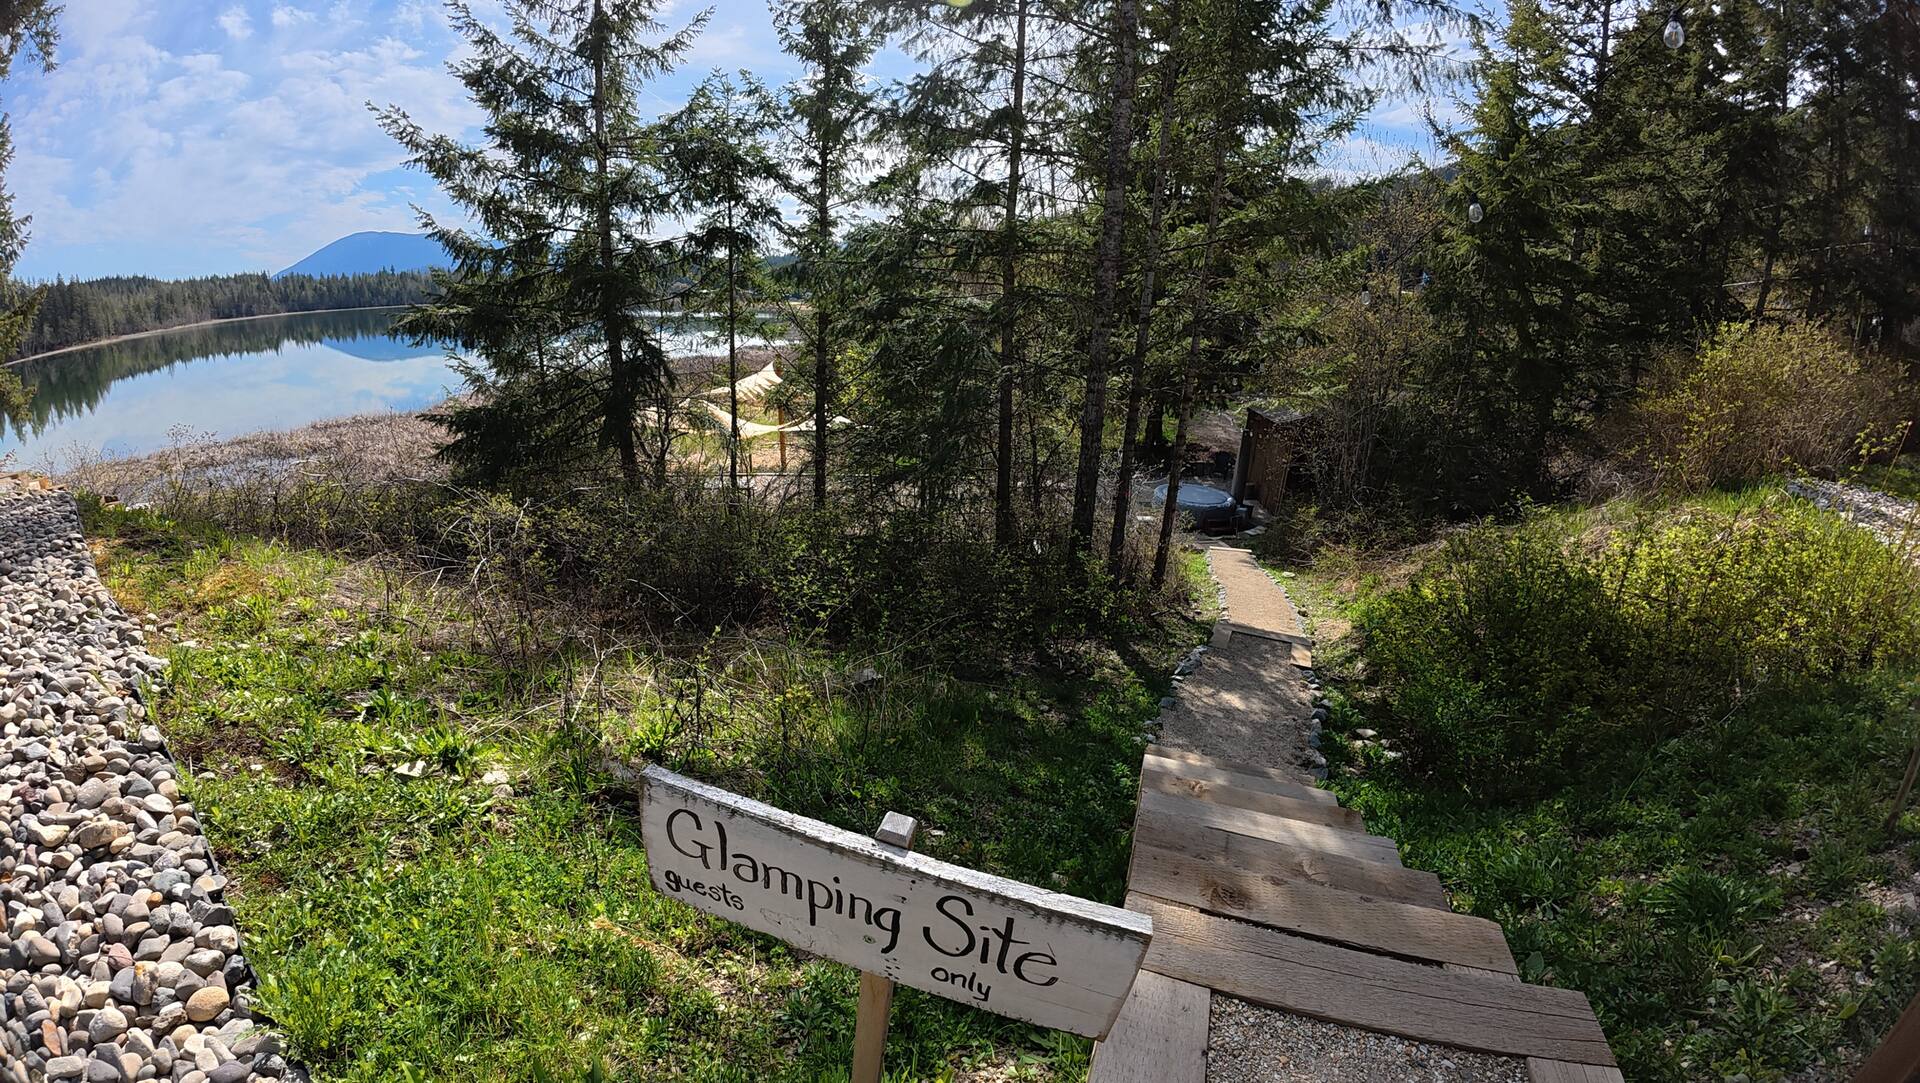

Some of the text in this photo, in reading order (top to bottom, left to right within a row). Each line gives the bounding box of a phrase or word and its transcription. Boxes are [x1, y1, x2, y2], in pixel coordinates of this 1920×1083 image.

[665, 869, 992, 1001] guests only
[666, 808, 1059, 987] Glamping Site
